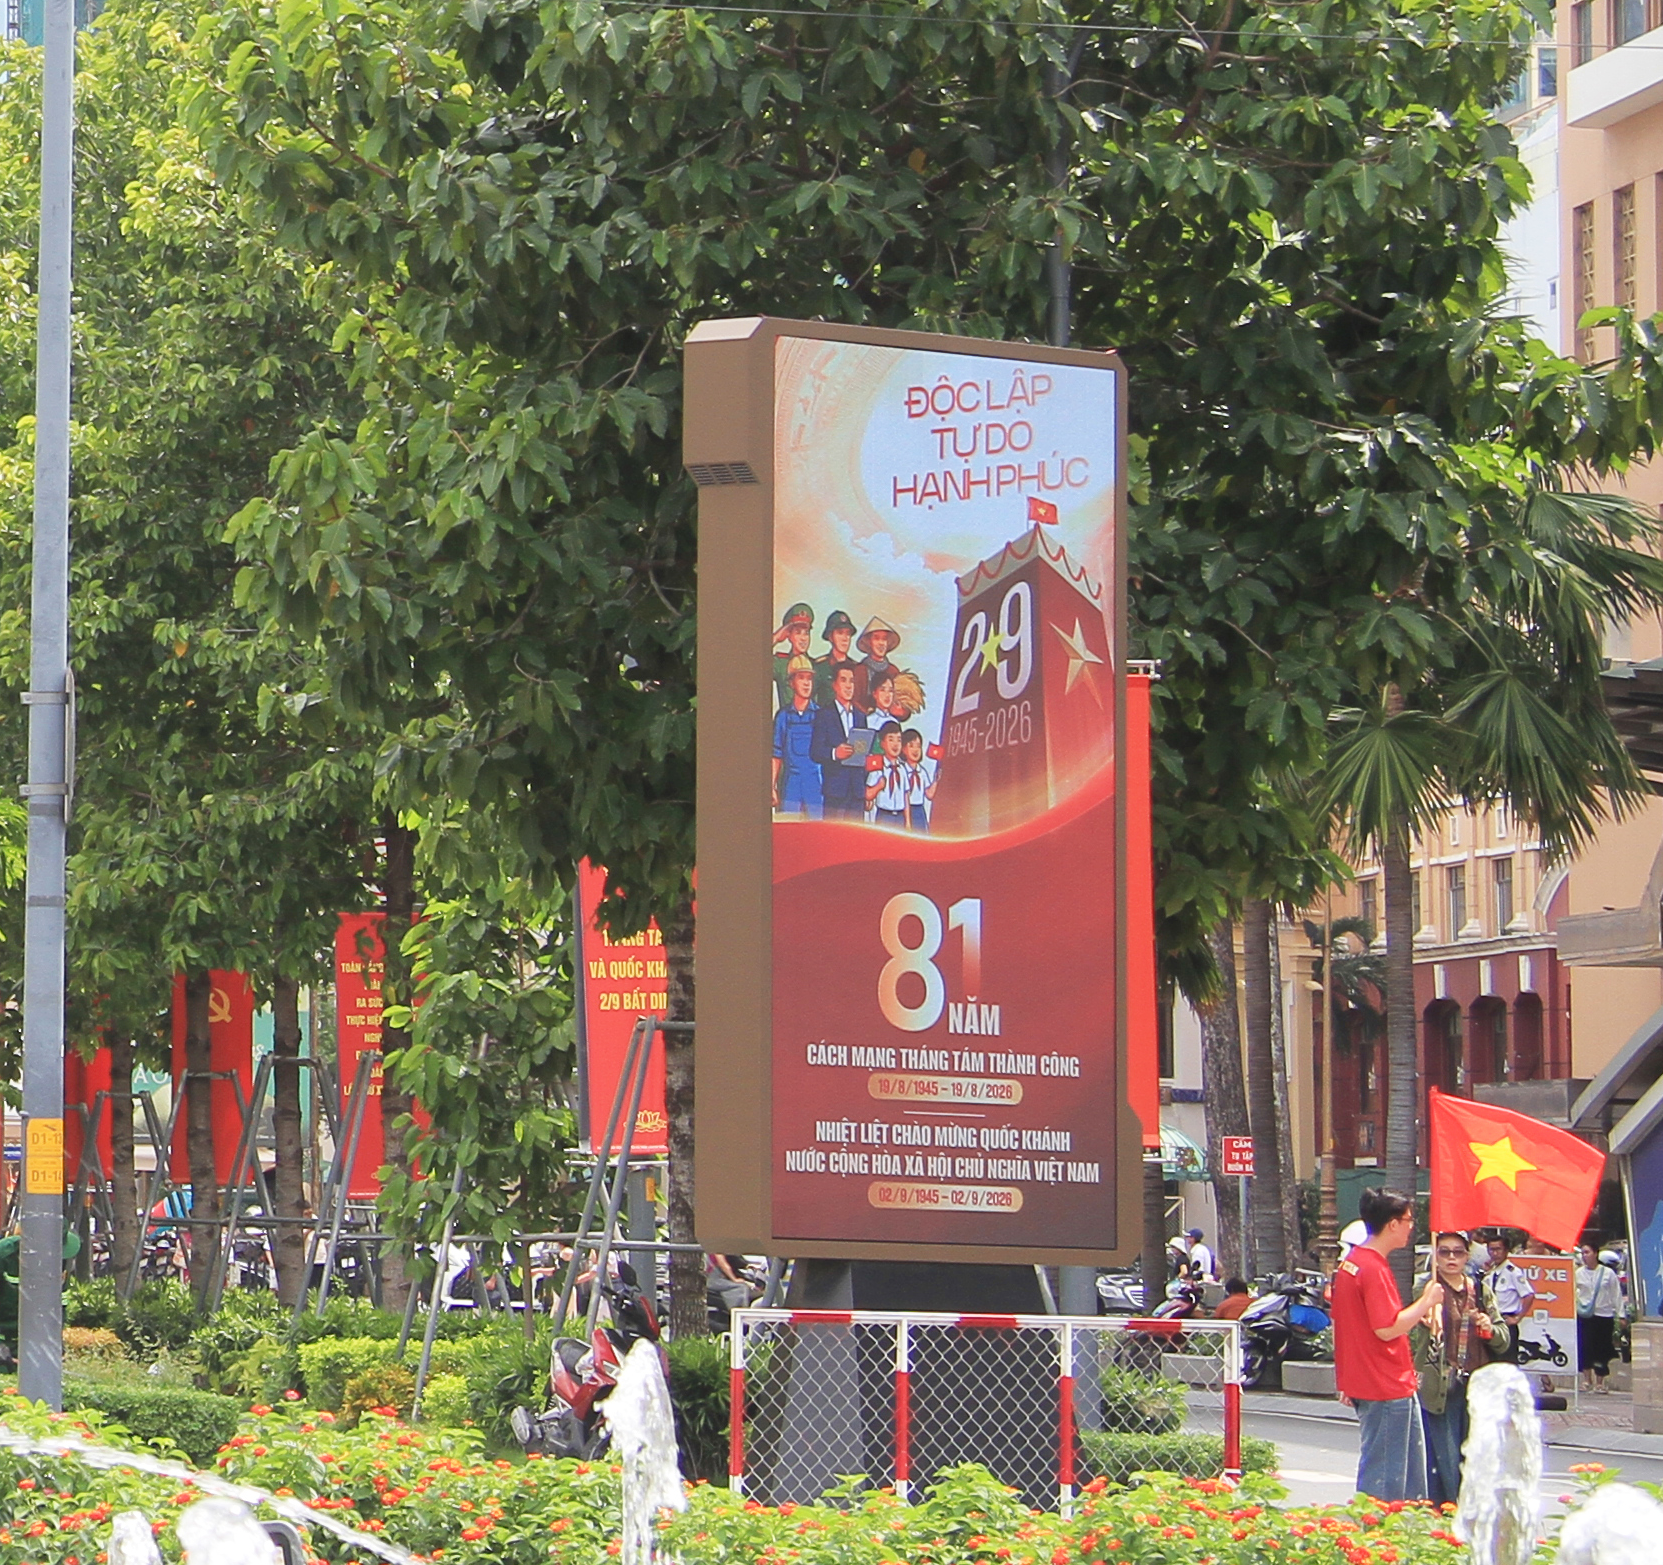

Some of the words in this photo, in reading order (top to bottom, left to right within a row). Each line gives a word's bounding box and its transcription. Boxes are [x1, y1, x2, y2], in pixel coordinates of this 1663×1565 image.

[904, 375, 981, 422] ĐỘC
[986, 368, 1053, 413] LẬP
[930, 422, 983, 464] TỰ
[985, 420, 1033, 455] DO
[892, 466, 991, 511] HẠNH
[996, 450, 1089, 497] PHÚC
[946, 700, 1032, 758] 1945-2026
[589, 957, 607, 979] VÀ
[609, 954, 644, 981] QUỐC
[877, 891, 982, 1032] 81
[599, 992, 620, 1011] 2/9
[622, 987, 647, 1011] BẤT
[948, 995, 1002, 1036] NĂM
[806, 1039, 848, 1066] CÁCH
[851, 1045, 896, 1072] MẠNG
[899, 1044, 949, 1071] THÁNG
[952, 1046, 985, 1073] TÁM
[988, 1049, 1037, 1076] THÀNH
[1040, 1051, 1080, 1078] CÔNG
[878, 1078, 939, 1096] 19/8/1945
[951, 1082, 1013, 1099] 19/8/2026
[815, 1117, 858, 1147] NHIỆT
[860, 1118, 890, 1149] LIỆT
[892, 1120, 931, 1147] CHÀO
[934, 1121, 977, 1149] MỪNG
[980, 1123, 1019, 1152] QUỐC
[1022, 1125, 1071, 1153] KHÁNH
[785, 1146, 827, 1173] NƯỚC
[829, 1147, 869, 1178] CỘNG
[871, 1150, 902, 1176] HÒA
[904, 1151, 924, 1177] XÃ
[927, 1151, 952, 1182] HỘI
[954, 1152, 985, 1179] CHỦ
[987, 1154, 1032, 1181] NGHĨA
[1034, 1156, 1065, 1186] VIỆT
[1067, 1161, 1100, 1184] NAM
[878, 1187, 939, 1204] 02/9/1945
[951, 1190, 1012, 1206] 02/9/2026
[1544, 1268, 1568, 1282] XE
